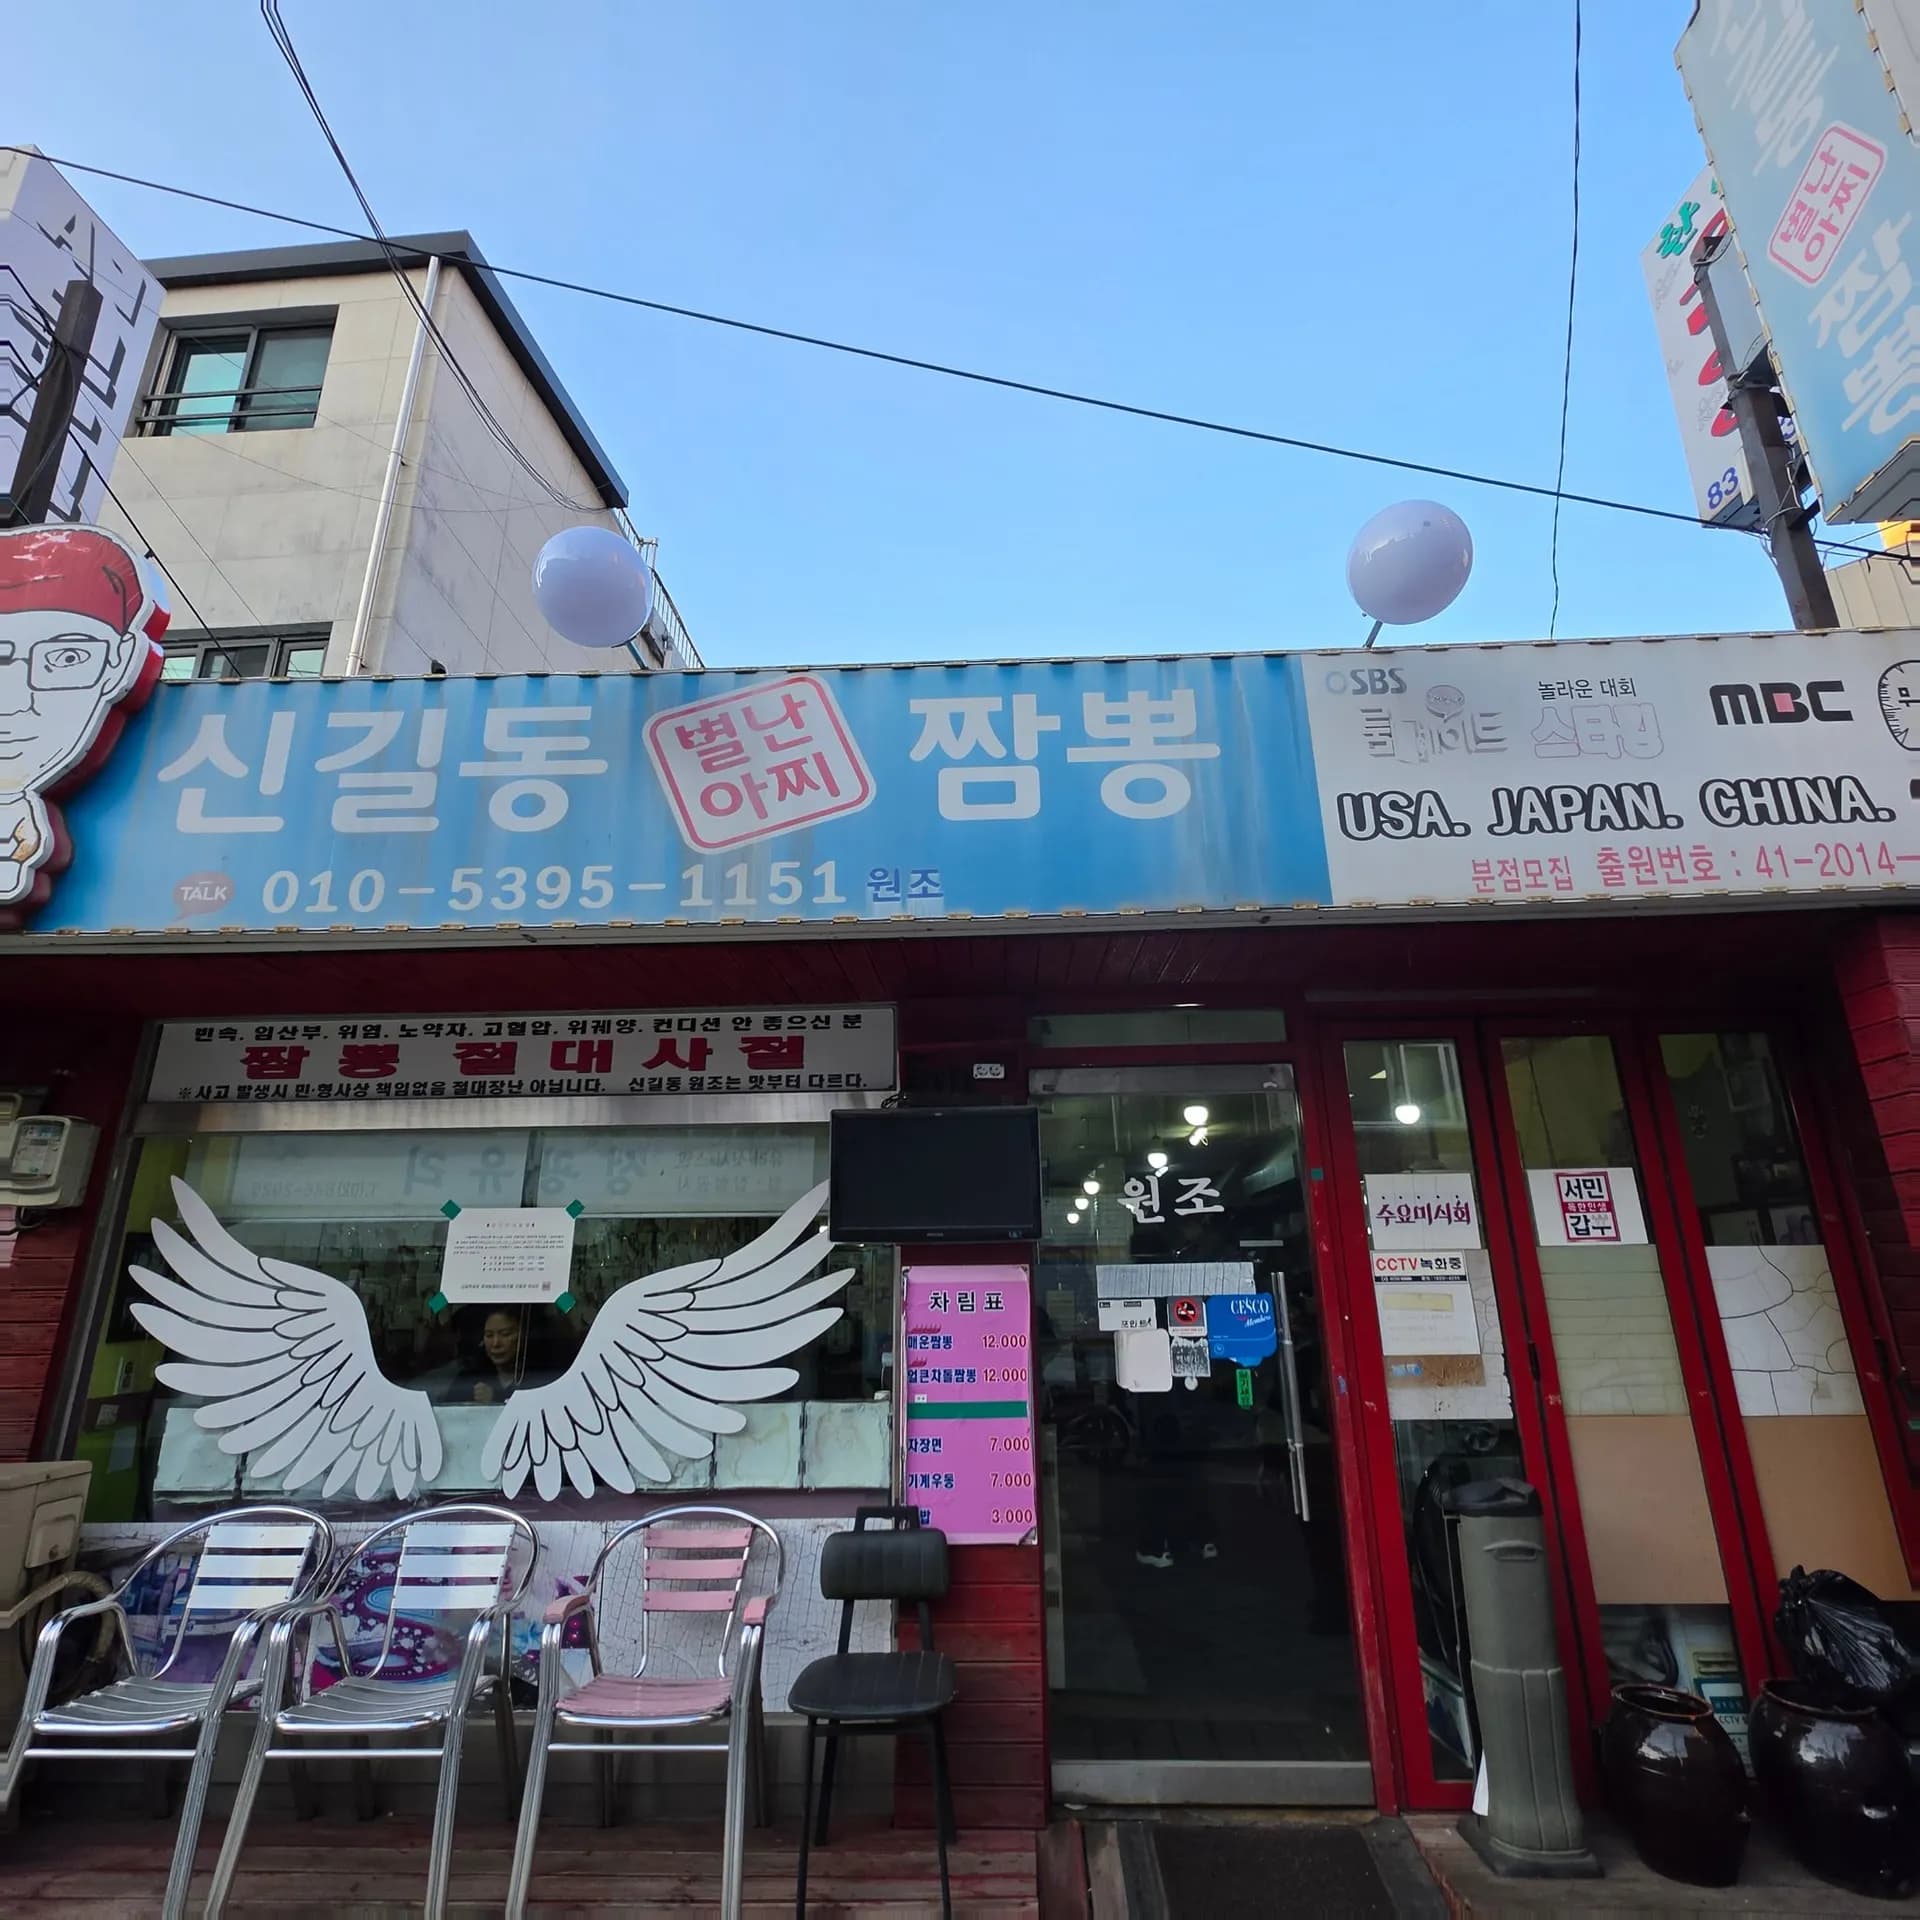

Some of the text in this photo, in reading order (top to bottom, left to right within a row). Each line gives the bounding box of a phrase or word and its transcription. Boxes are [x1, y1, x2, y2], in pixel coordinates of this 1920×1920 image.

[1780, 145, 1844, 243] 별난
[1804, 163, 1870, 263] 아찌
[1350, 667, 1408, 696] SBS
[1538, 677, 1637, 701] 놀라운 대회
[1709, 680, 1854, 726] MBC
[675, 689, 816, 774] 별난
[157, 705, 609, 834] 신길동
[909, 687, 1221, 821] 짬뽕
[699, 751, 841, 821] 아찌
[1336, 775, 1897, 841] USA. JAPAN. CHINA.
[867, 866, 945, 903] 원조
[1471, 855, 1575, 893] 분점모집
[1597, 843, 1721, 888] 출원번호
[180, 885, 228, 902] TALK
[254, 1024, 329, 1041] 임산부.
[338, 1023, 389, 1040] 위염.
[398, 1021, 473, 1039] 노약자.
[483, 1019, 559, 1037] 고혈압.
[567, 1018, 643, 1036] 위궤양.
[653, 1016, 721, 1034] 컨디션
[731, 1015, 753, 1032] 안
[842, 1013, 863, 1030] 분
[236, 1083, 288, 1100] 발생시
[375, 1080, 447, 1098] 책임없음
[451, 1079, 524, 1096] 절대장난
[529, 1078, 606, 1094] 아닙니다.
[628, 1076, 682, 1093] 신길동
[687, 1075, 742, 1091] 원조는
[748, 1074, 801, 1090] 맛부터
[807, 1073, 867, 1089] 다르다.
[1117, 1175, 1225, 1224] 원조
[1565, 1177, 1605, 1200] 서민
[1375, 1199, 1472, 1227] 수요미식회
[1375, 1256, 1462, 1272] CCTV 녹화중
[1230, 1298, 1270, 1315] CESCO
[906, 1335, 953, 1351] 매운짬뽕
[908, 1473, 955, 1489] 기계우동
